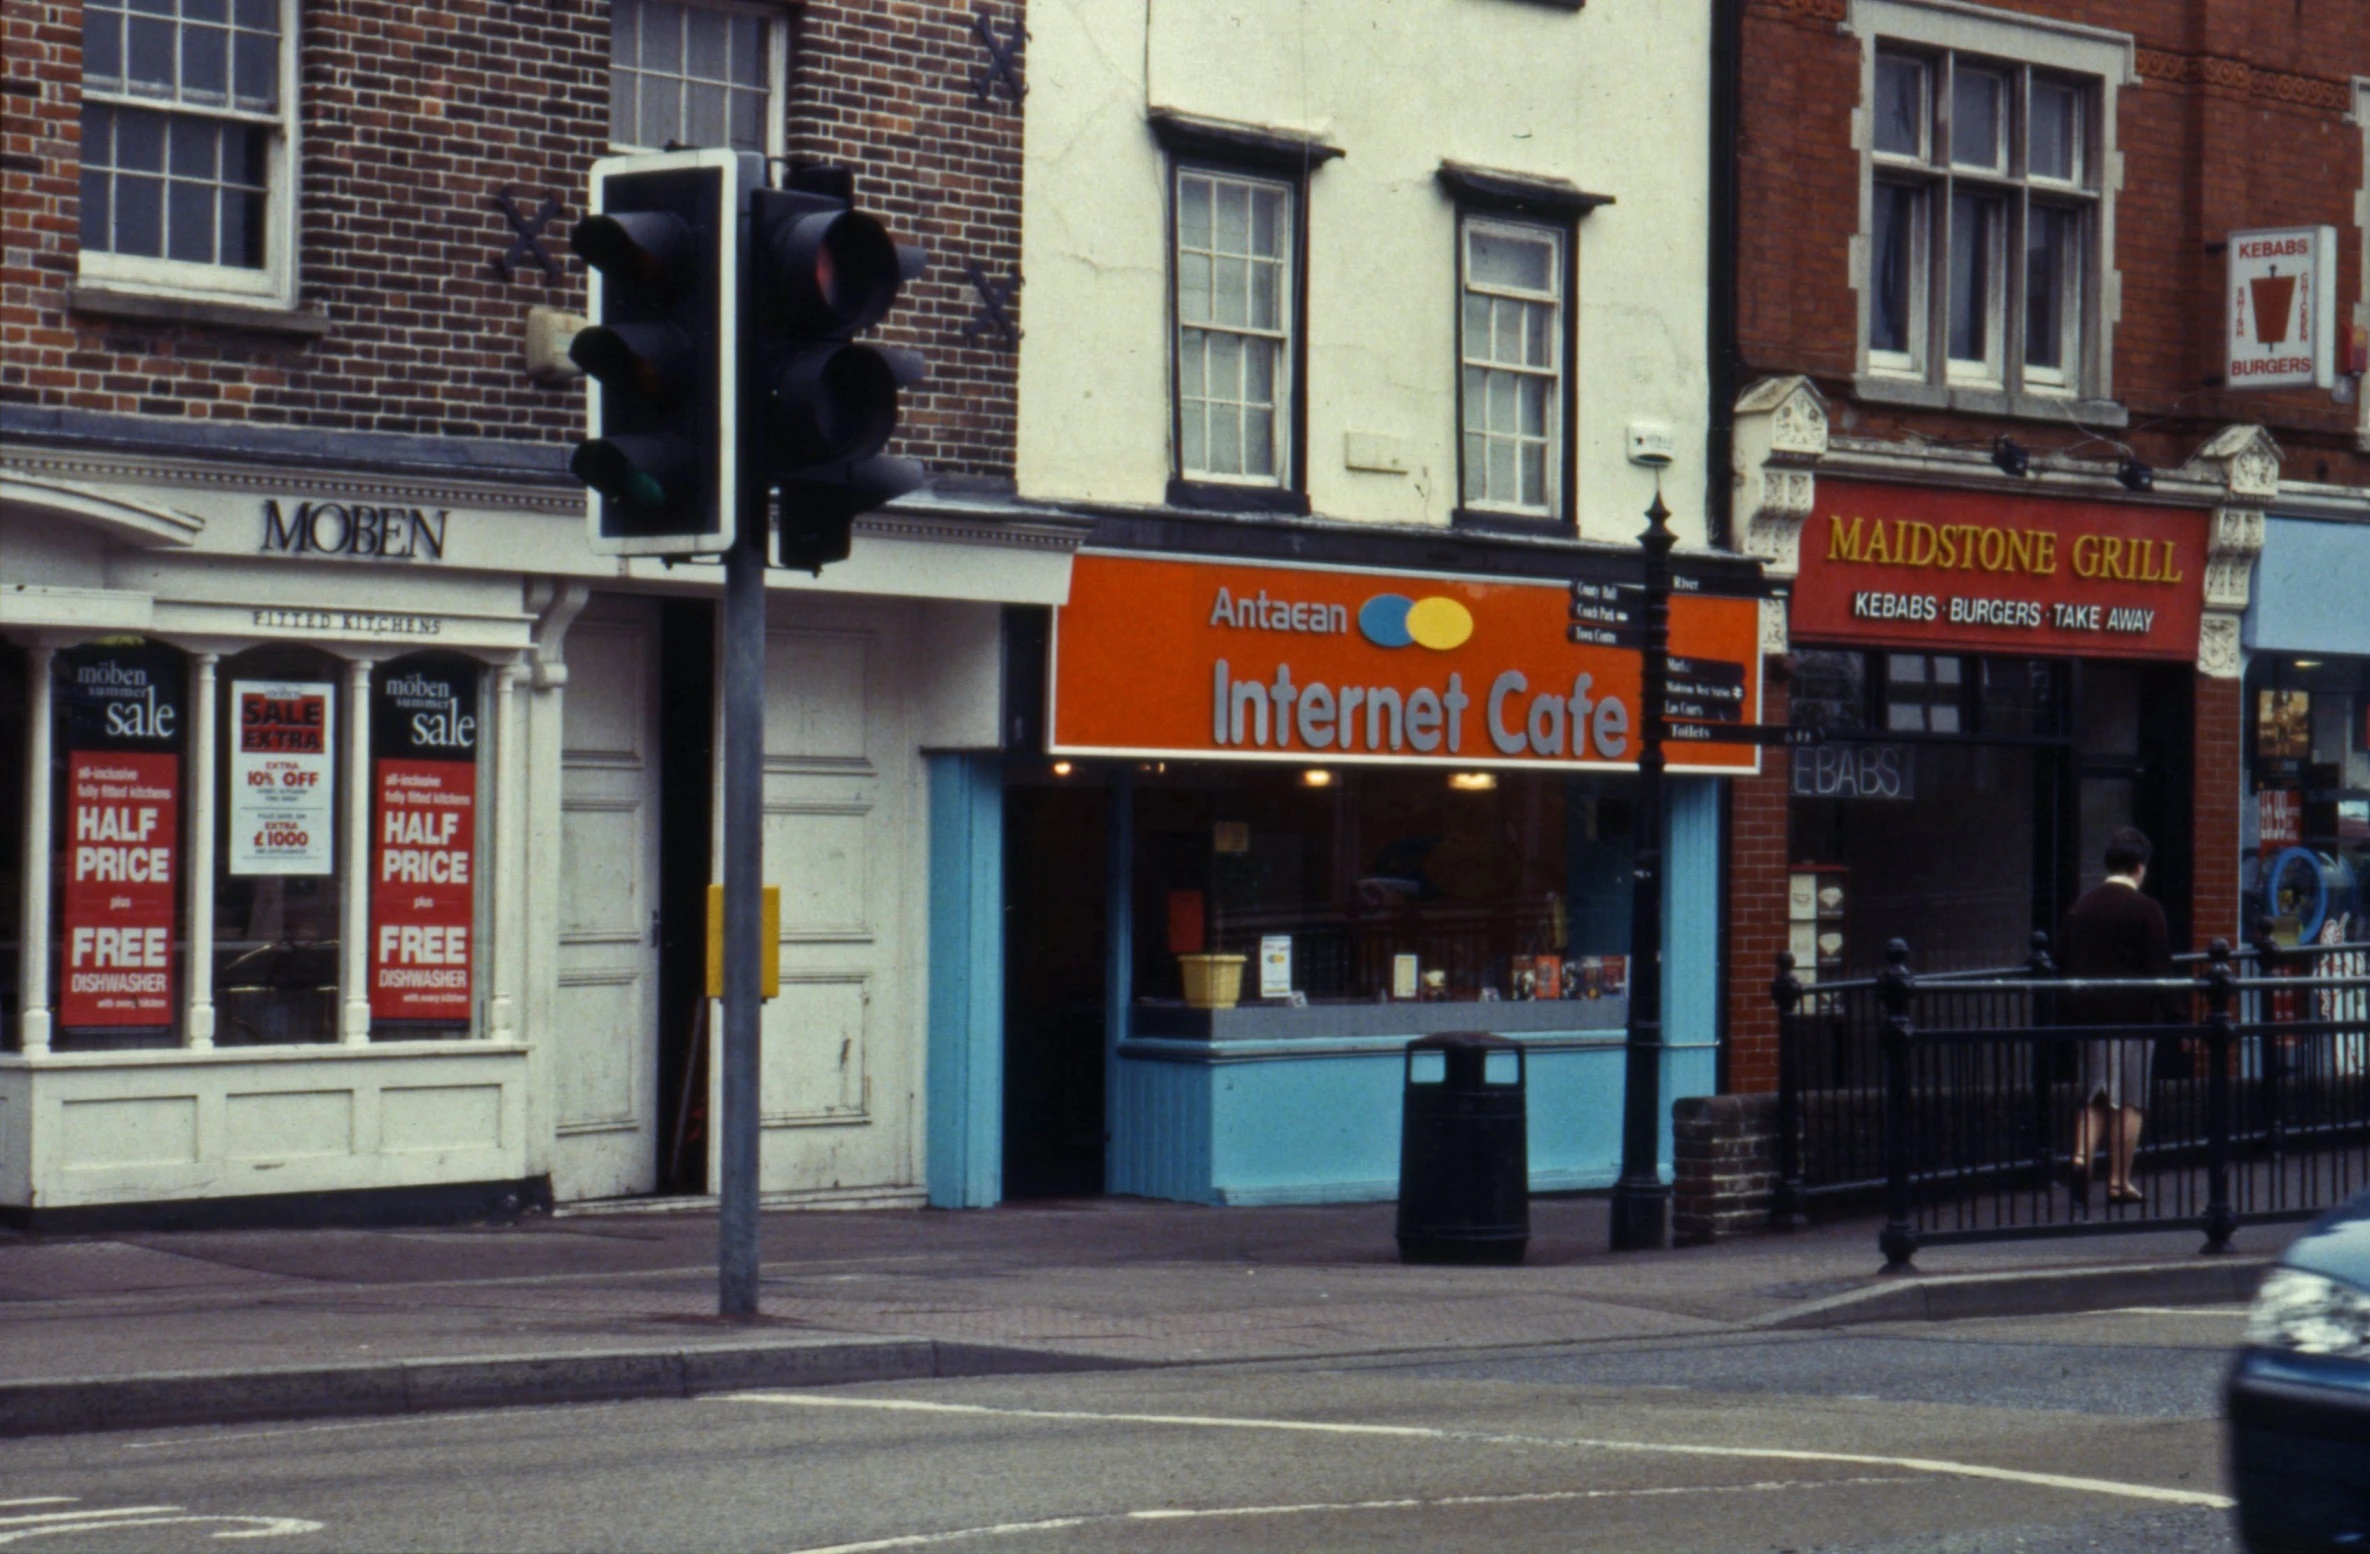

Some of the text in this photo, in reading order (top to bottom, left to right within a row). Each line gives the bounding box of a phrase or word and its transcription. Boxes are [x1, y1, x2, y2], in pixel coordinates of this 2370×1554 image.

[2238, 238, 2309, 259] KEBABS
[2235, 286, 2245, 338] SHISH
[2230, 356, 2313, 377] BURGERS
[258, 498, 450, 560] MOBEN
[1826, 514, 2183, 583] MAIDSTONE GRILL
[1672, 574, 1699, 591] River
[252, 609, 442, 635] FITTED KITCHENS
[1209, 585, 1348, 634] Antaean
[1854, 591, 2155, 633] KEBABS BURGERS TAKE AWAY
[77, 660, 147, 686] möben
[385, 672, 450, 698] möben
[105, 684, 176, 738] sale
[243, 700, 322, 726] SALE
[411, 696, 476, 748] sale
[1213, 657, 1629, 759] Internet Cafe
[243, 729, 321, 750] EXTRA
[1671, 723, 1711, 740] Toilets
[247, 771, 320, 787] 10% OFF
[265, 761, 300, 770] EXTRA
[1793, 746, 1901, 797] EBABS
[76, 805, 159, 842] HALF
[264, 821, 298, 830] EXTRA
[384, 811, 460, 845] HALF
[253, 831, 309, 847] £1000
[75, 847, 170, 883] PRICE
[382, 849, 469, 884] PRICE
[71, 926, 168, 968] FREE
[378, 925, 467, 965] FREE
[71, 972, 167, 993] DISHWASHER
[378, 968, 467, 988] DISHWASHER
